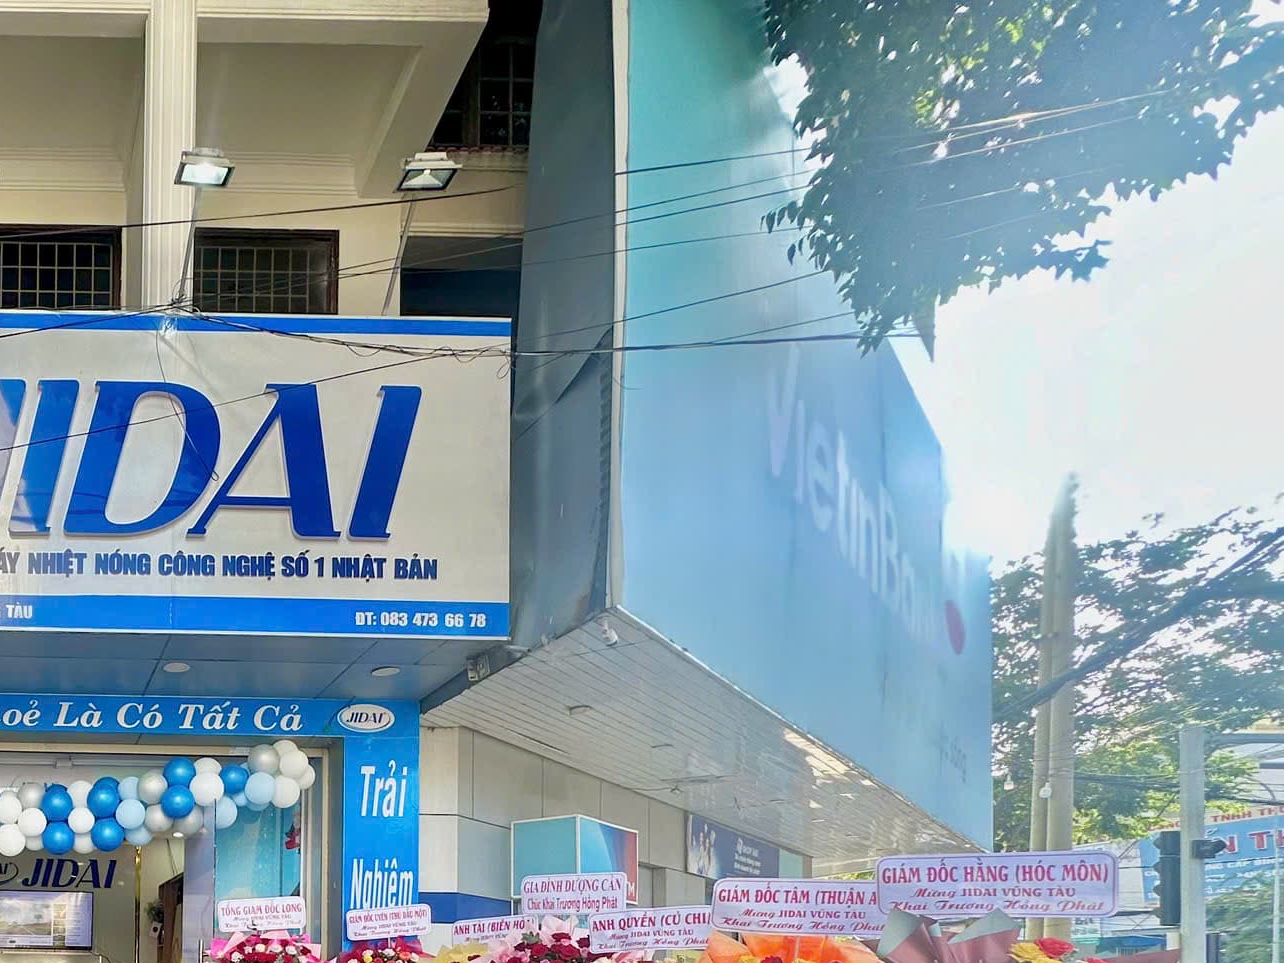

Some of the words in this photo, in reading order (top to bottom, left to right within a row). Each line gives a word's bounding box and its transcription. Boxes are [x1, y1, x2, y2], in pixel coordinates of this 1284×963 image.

[27, 548, 87, 577] NHIỆT
[95, 549, 151, 576] NÓNG
[158, 550, 215, 577] CÔNG
[222, 552, 276, 581] NGHỆ
[281, 550, 310, 578] SỐ
[314, 556, 324, 578] 1
[332, 553, 387, 582] NHẬT
[393, 553, 438, 580] BẢN
[6, 601, 32, 619] TÀU
[355, 611, 377, 627] ĐT:
[380, 612, 408, 627] 083
[413, 613, 438, 628] 473
[445, 613, 463, 628] 66
[469, 613, 486, 628] 78
[54, 701, 103, 727] Là
[117, 702, 163, 729] Có
[178, 700, 241, 731] Tất
[254, 704, 303, 732] Cả
[347, 712, 387, 724] JIDAI
[360, 760, 408, 817] Trải
[22, 859, 116, 889] JIDAI
[882, 863, 921, 884] GIÁM
[927, 858, 958, 883] ĐỐC
[964, 857, 1009, 883] HẰNG
[1015, 860, 1054, 884] (HÓC
[1062, 859, 1109, 884] MÔN)
[718, 885, 750, 903] GIÁM
[755, 882, 778, 903] ĐỐC
[783, 886, 810, 905] TÂM
[1003, 885, 1042, 897] VŨNG
[1047, 886, 1076, 897] TÀU
[454, 924, 470, 936] ANH
[592, 919, 615, 932] ANH
